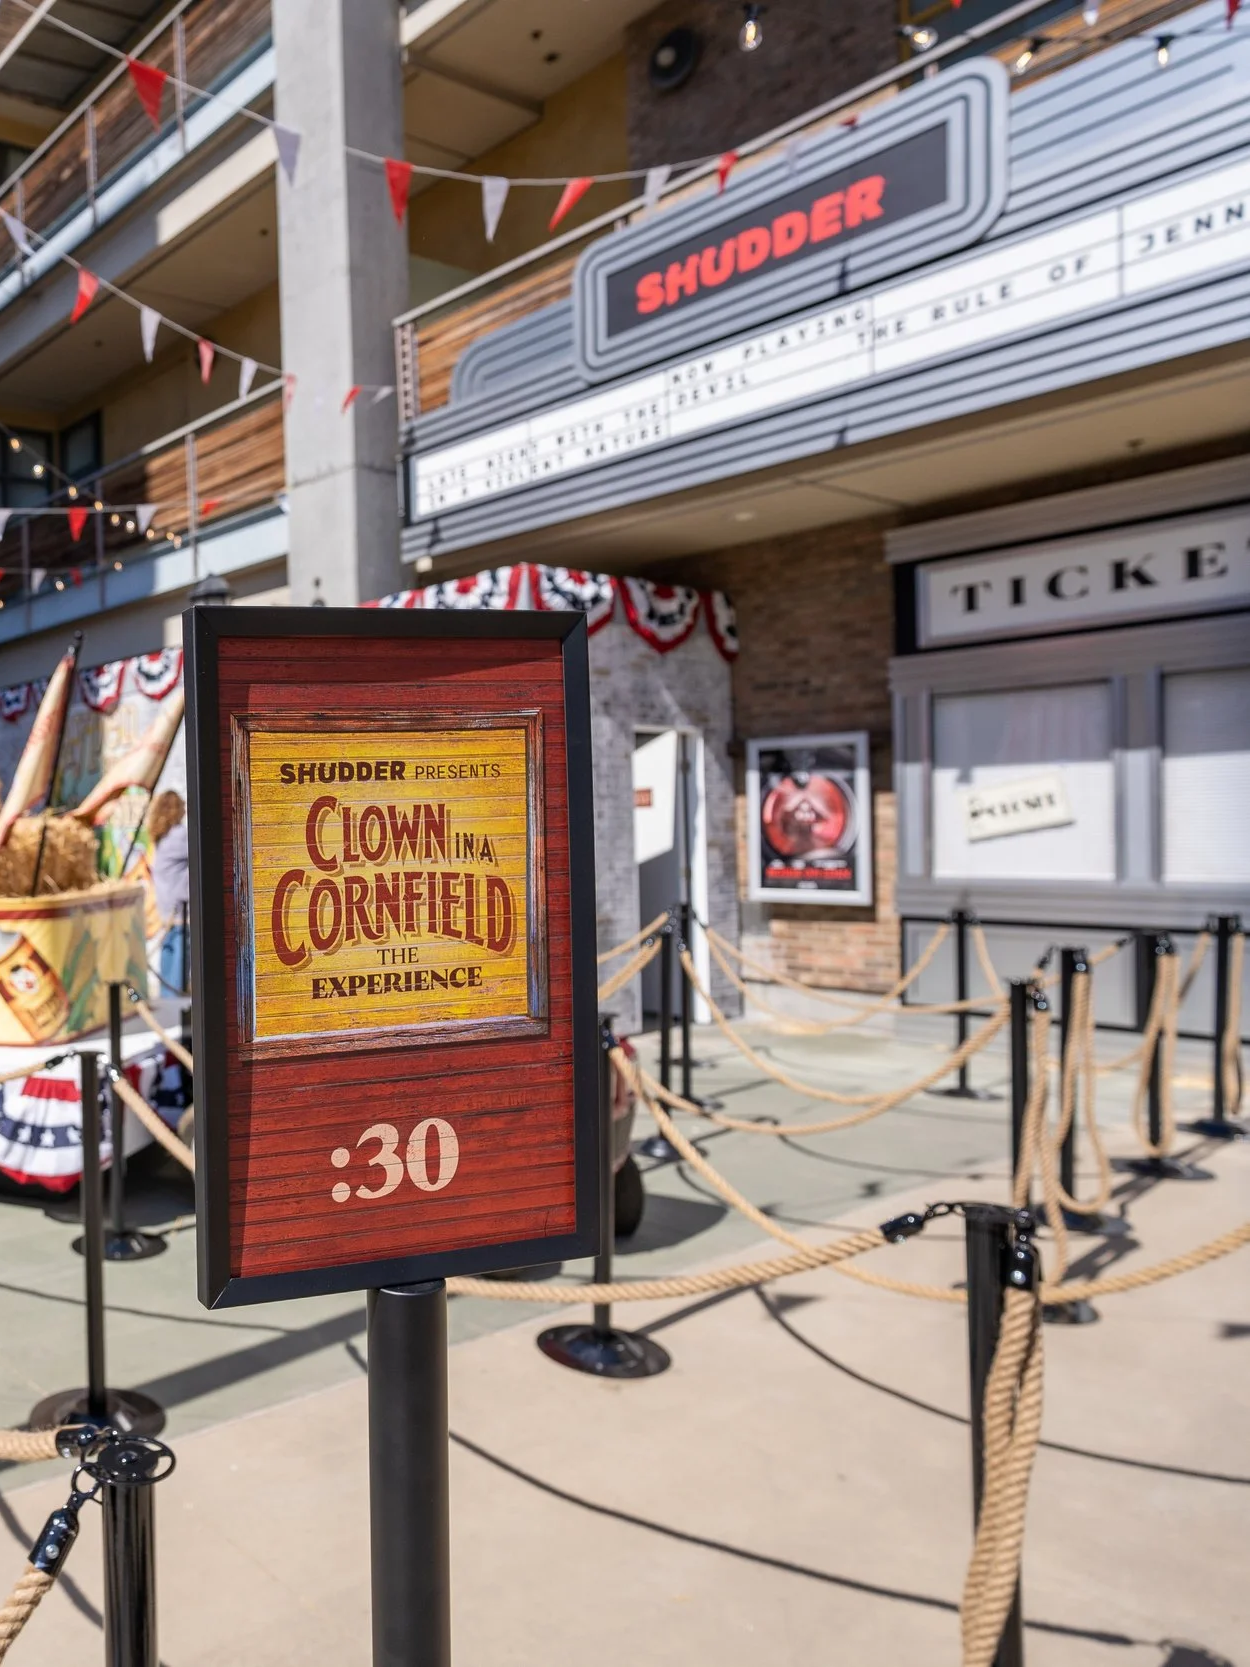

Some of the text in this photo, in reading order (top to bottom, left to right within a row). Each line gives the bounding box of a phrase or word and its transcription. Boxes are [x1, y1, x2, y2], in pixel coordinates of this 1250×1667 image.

[636, 174, 886, 314] SHUDDER
[857, 202, 1245, 346] THE RULE OF JENN
[672, 308, 865, 385] NOW PLAYING
[624, 404, 660, 423] THE
[677, 373, 748, 406] DEVIL
[950, 537, 1250, 616] TICKE
[280, 760, 500, 785] SHUDDER PRESENTS
[306, 795, 494, 873] CLOWN IN A
[272, 869, 513, 967] CORNFIELD
[377, 946, 419, 966] THE
[312, 966, 482, 999] EXPERIENCE
[331, 1117, 459, 1202] :30
